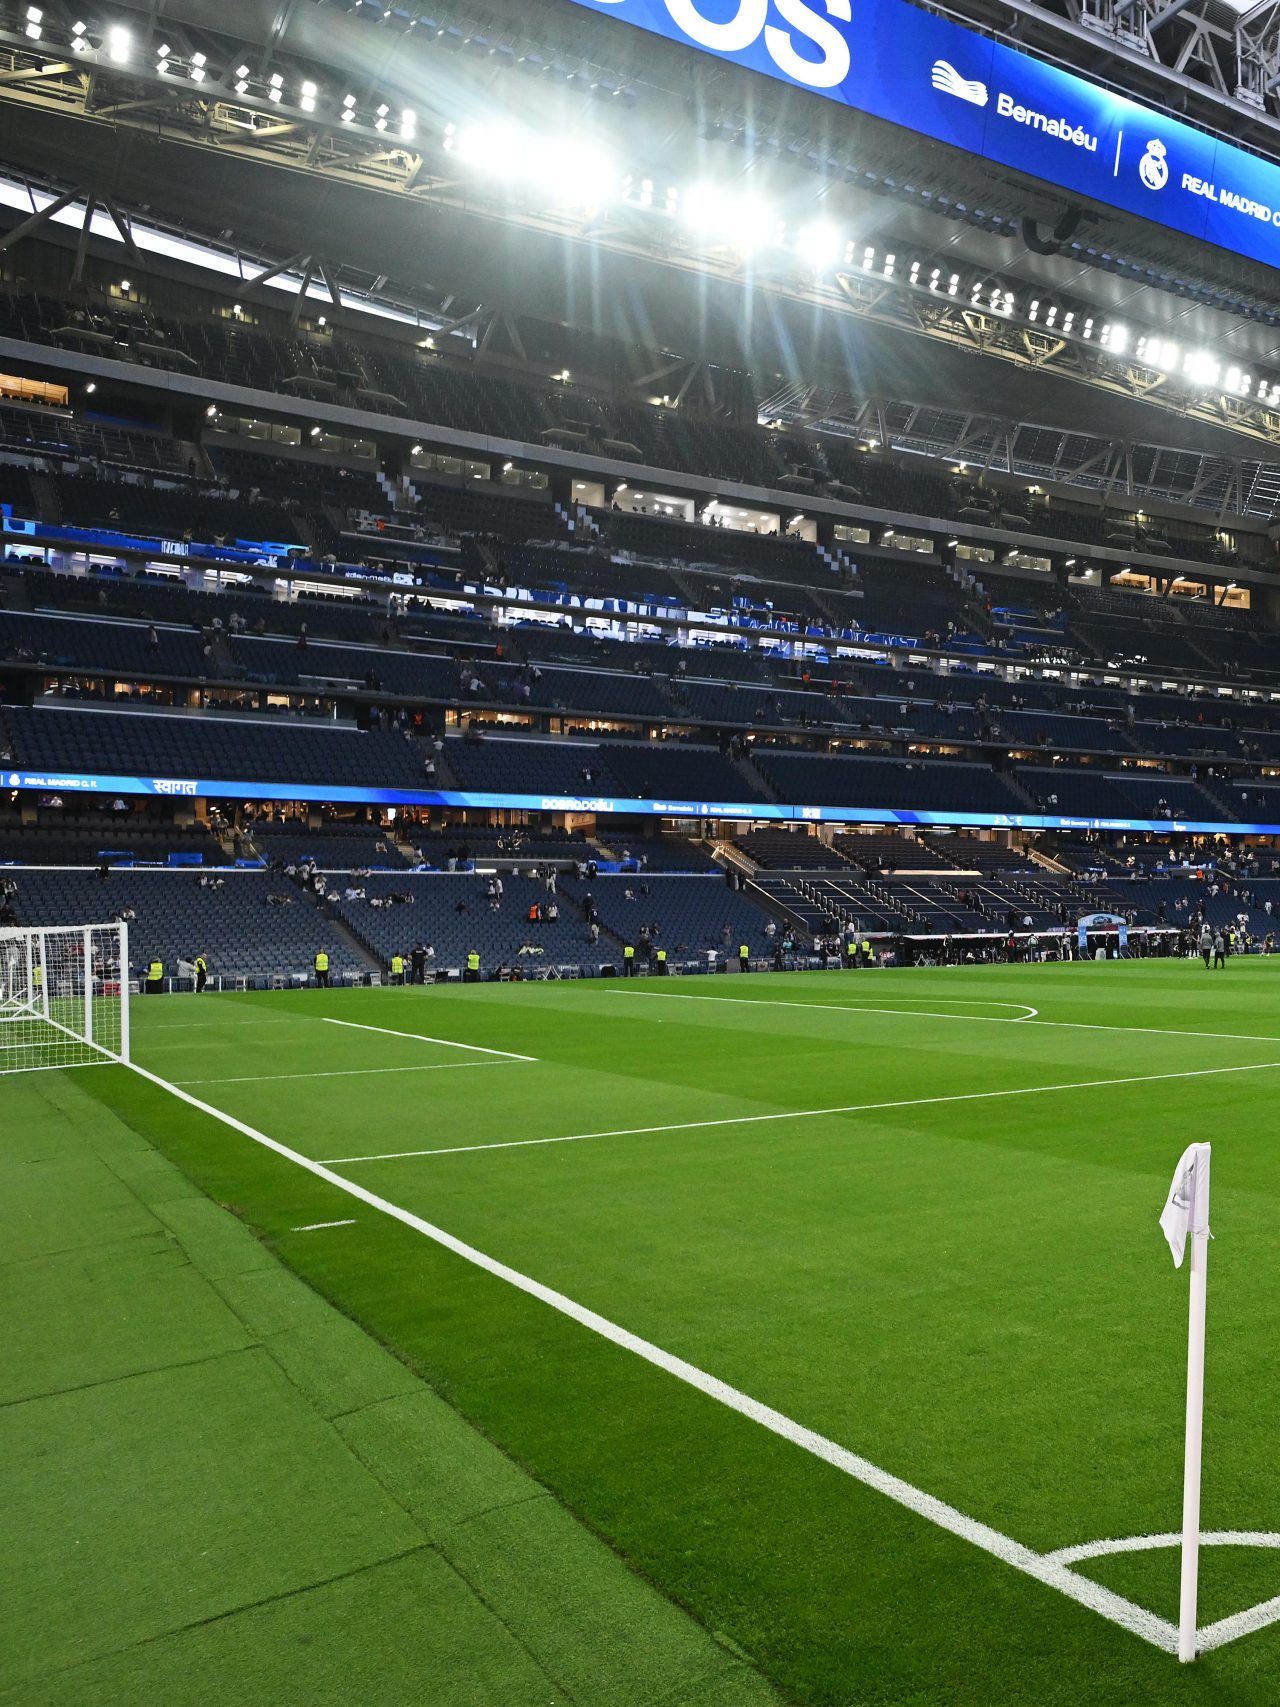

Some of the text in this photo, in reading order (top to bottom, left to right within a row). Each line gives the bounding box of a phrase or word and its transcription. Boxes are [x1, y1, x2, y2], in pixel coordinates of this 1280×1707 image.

[997, 92, 1098, 152] Bernabéu
[1181, 173, 1218, 202] REAL
[1219, 188, 1272, 223] MADRID
[153, 779, 198, 795] स्वागत
